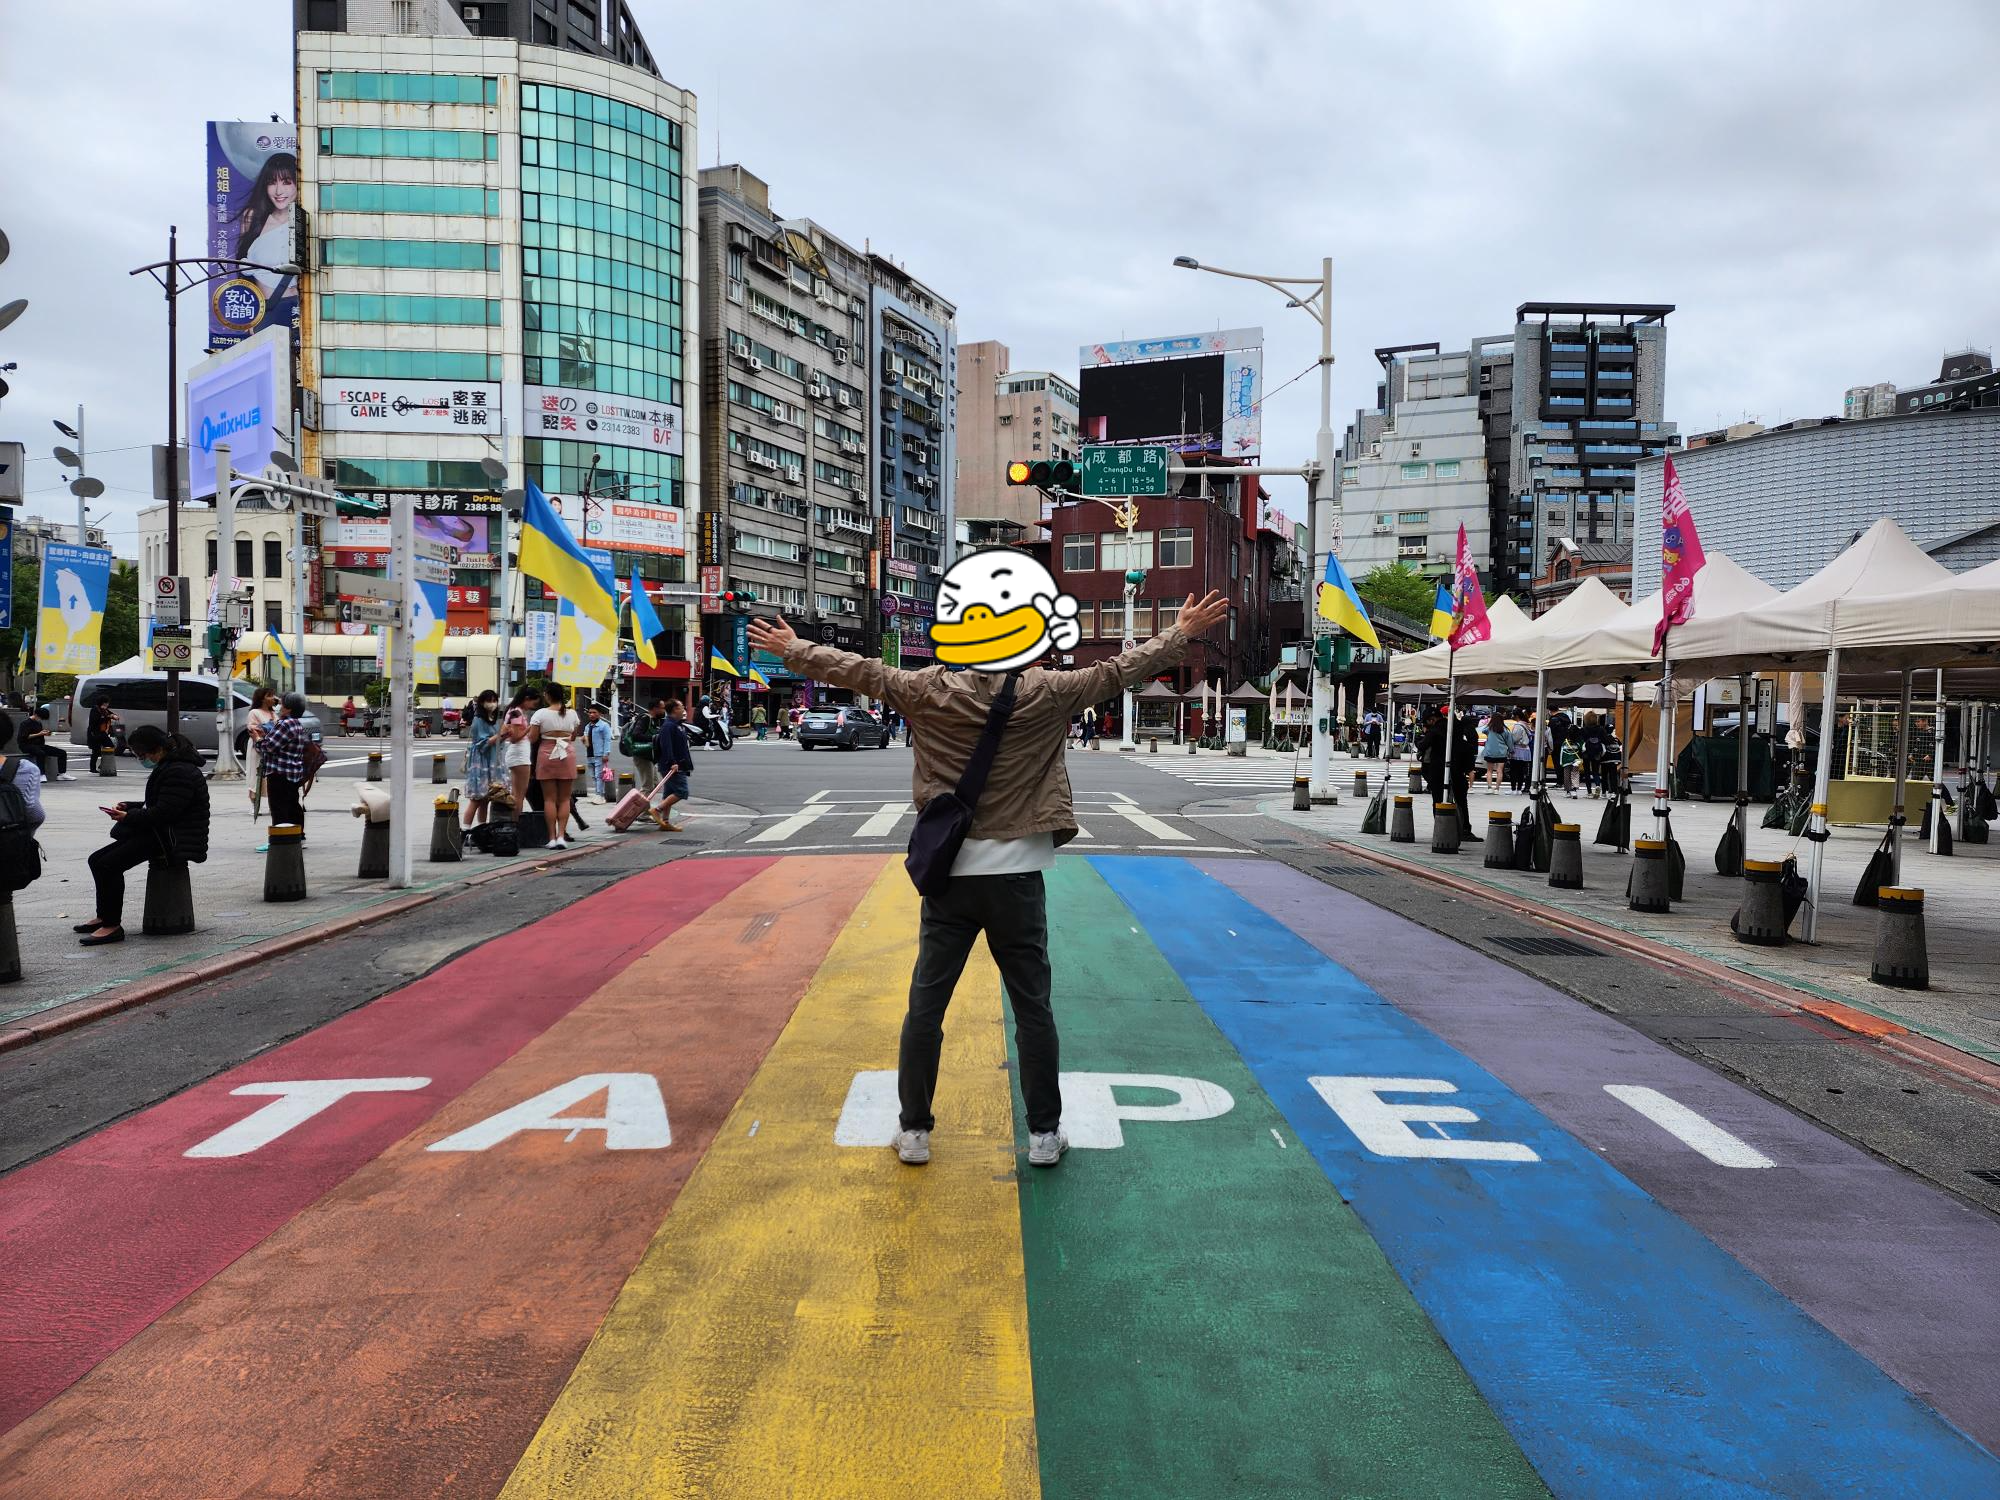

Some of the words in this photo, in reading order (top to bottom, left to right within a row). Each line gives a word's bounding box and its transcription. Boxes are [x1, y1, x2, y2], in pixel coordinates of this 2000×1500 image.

[225, 289, 255, 305] 安心
[225, 304, 255, 319] 諮詢
[340, 391, 387, 403] ESCAPE
[452, 390, 487, 407] 密室
[351, 405, 388, 418] GAME
[453, 409, 487, 425] 逃脫
[649, 409, 675, 429] 本棟
[601, 421, 621, 433] 2314
[622, 423, 641, 436] 2383
[653, 427, 672, 446] 6/F
[1092, 449, 1157, 464] 成都路
[1103, 466, 1133, 474] ChengDu
[182, 1072, 1777, 1168] TAIPEI
